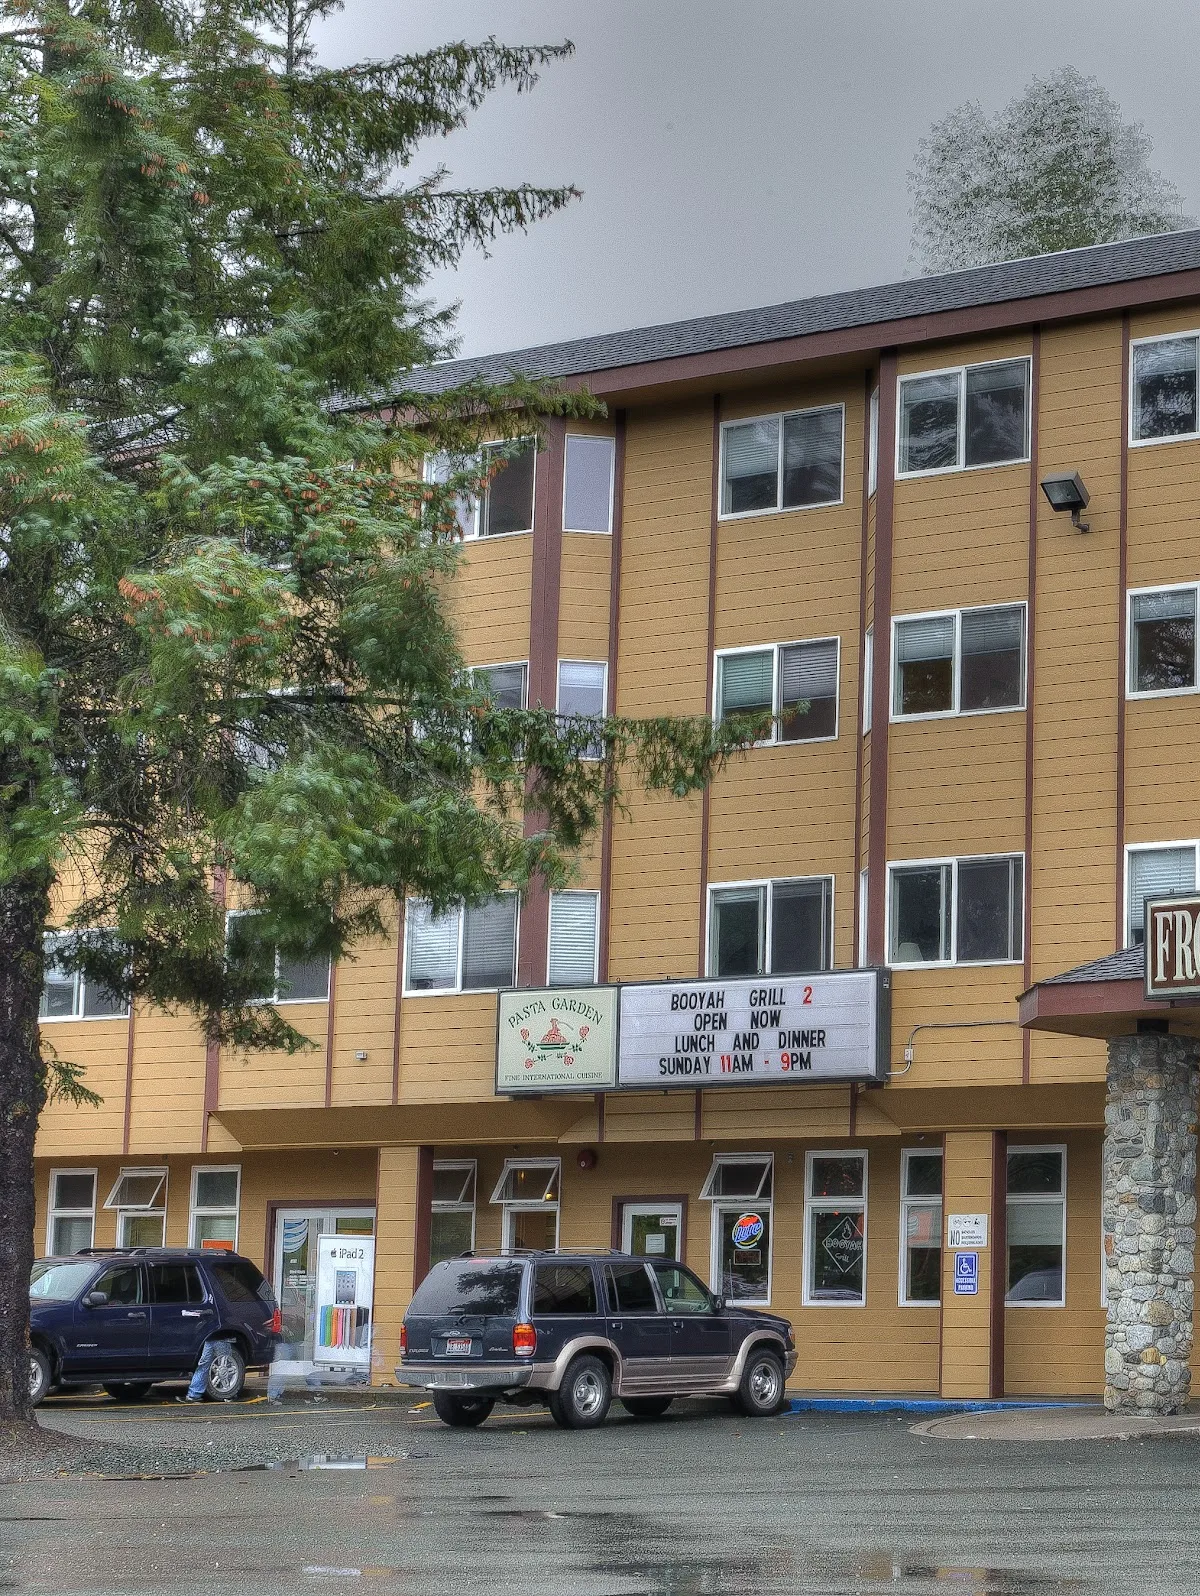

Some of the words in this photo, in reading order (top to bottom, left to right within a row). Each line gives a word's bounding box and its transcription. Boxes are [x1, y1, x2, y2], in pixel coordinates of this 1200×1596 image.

[671, 989, 725, 1011] BOOYAH
[749, 988, 786, 1007] GRILL
[802, 986, 813, 1005] 2
[508, 1001, 546, 1028] PASTA
[552, 997, 603, 1025] GARDEN
[694, 1012, 728, 1032] OPEN
[750, 1010, 781, 1030] NOW
[675, 1034, 715, 1054] LUNCH
[732, 1032, 760, 1051] AND
[778, 1029, 826, 1049] DINNER
[659, 1055, 711, 1076] SUNDAY
[720, 1053, 753, 1073] 11AM
[780, 1051, 812, 1072] 9PM
[522, 1073, 575, 1081] INTERNATIONAL
[577, 1071, 603, 1079] CUISINE
[950, 1229, 961, 1246] NO
[339, 1247, 358, 1259] iPad
[358, 1248, 365, 1260] 2
